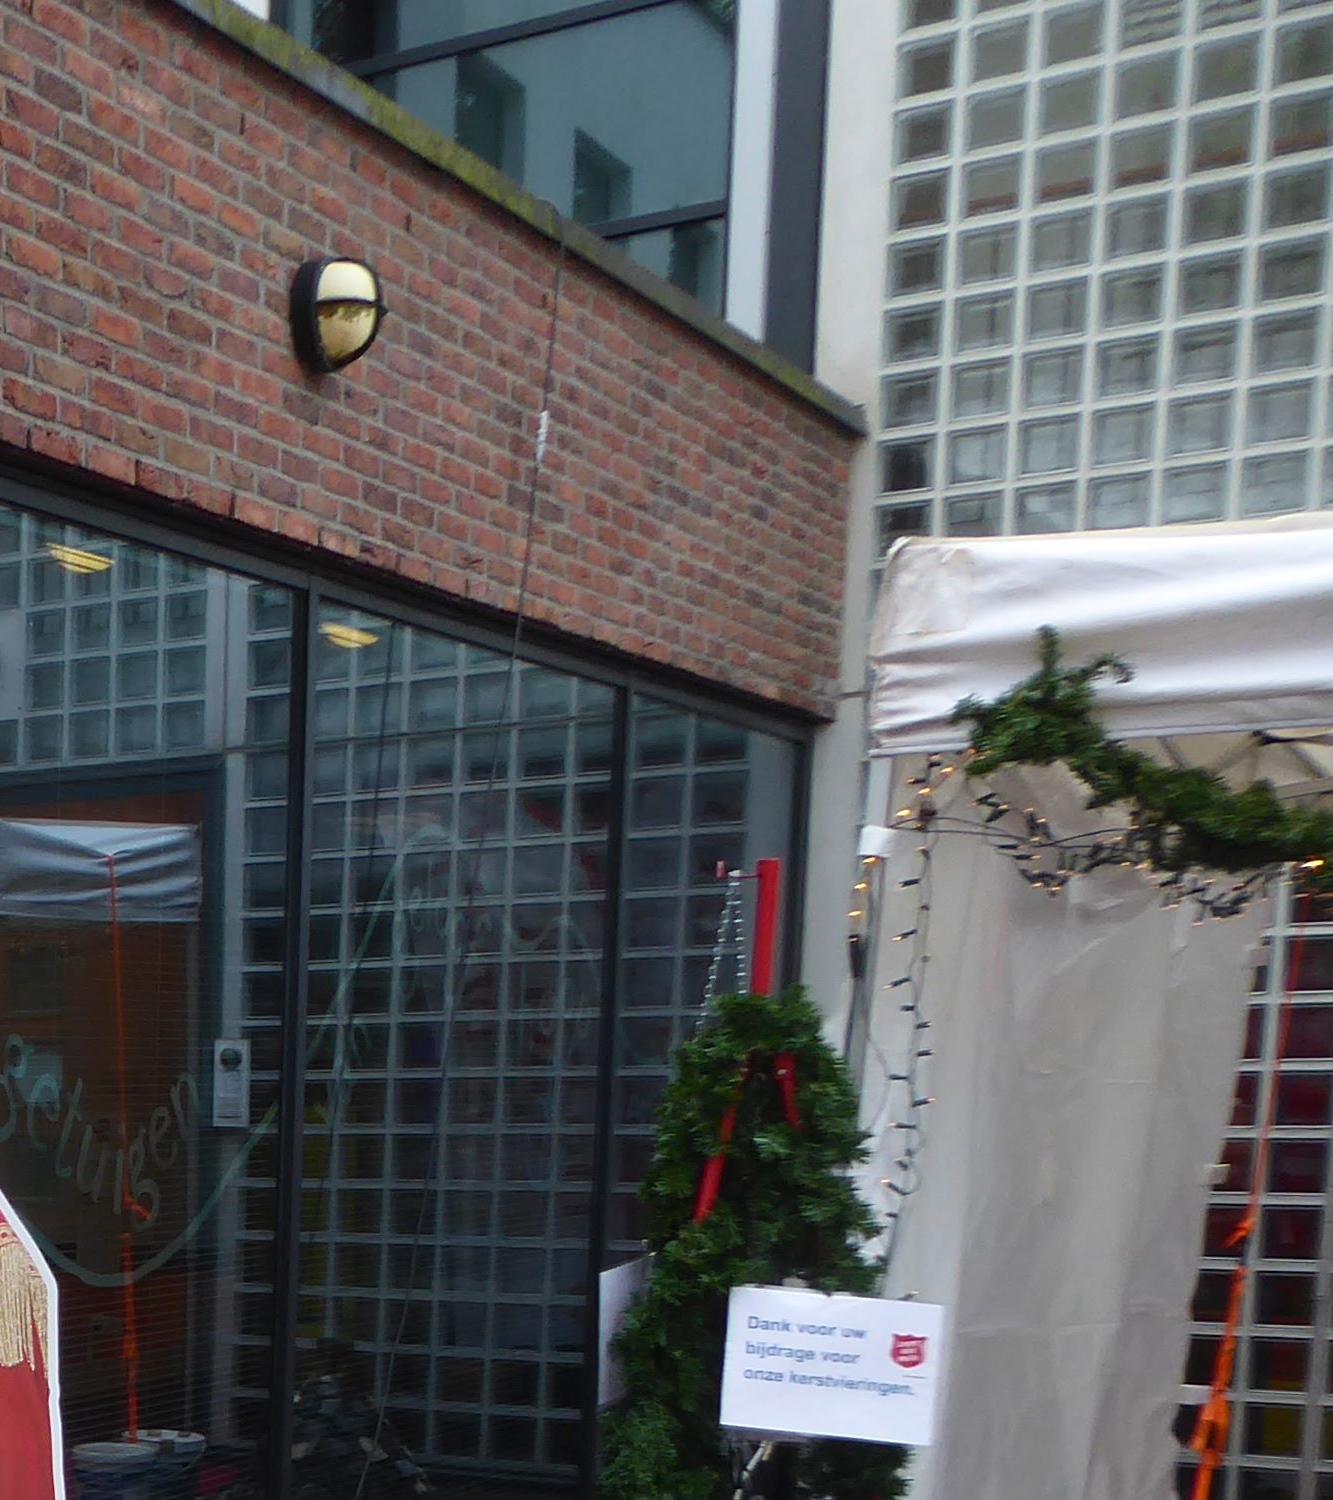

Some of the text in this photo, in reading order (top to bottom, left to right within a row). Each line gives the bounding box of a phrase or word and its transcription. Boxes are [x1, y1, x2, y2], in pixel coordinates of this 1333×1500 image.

[746, 1315, 868, 1340] Dank voor uw
[745, 1340, 861, 1365] bijdrage voor
[743, 1367, 916, 1397] onze kerstvieringen.
